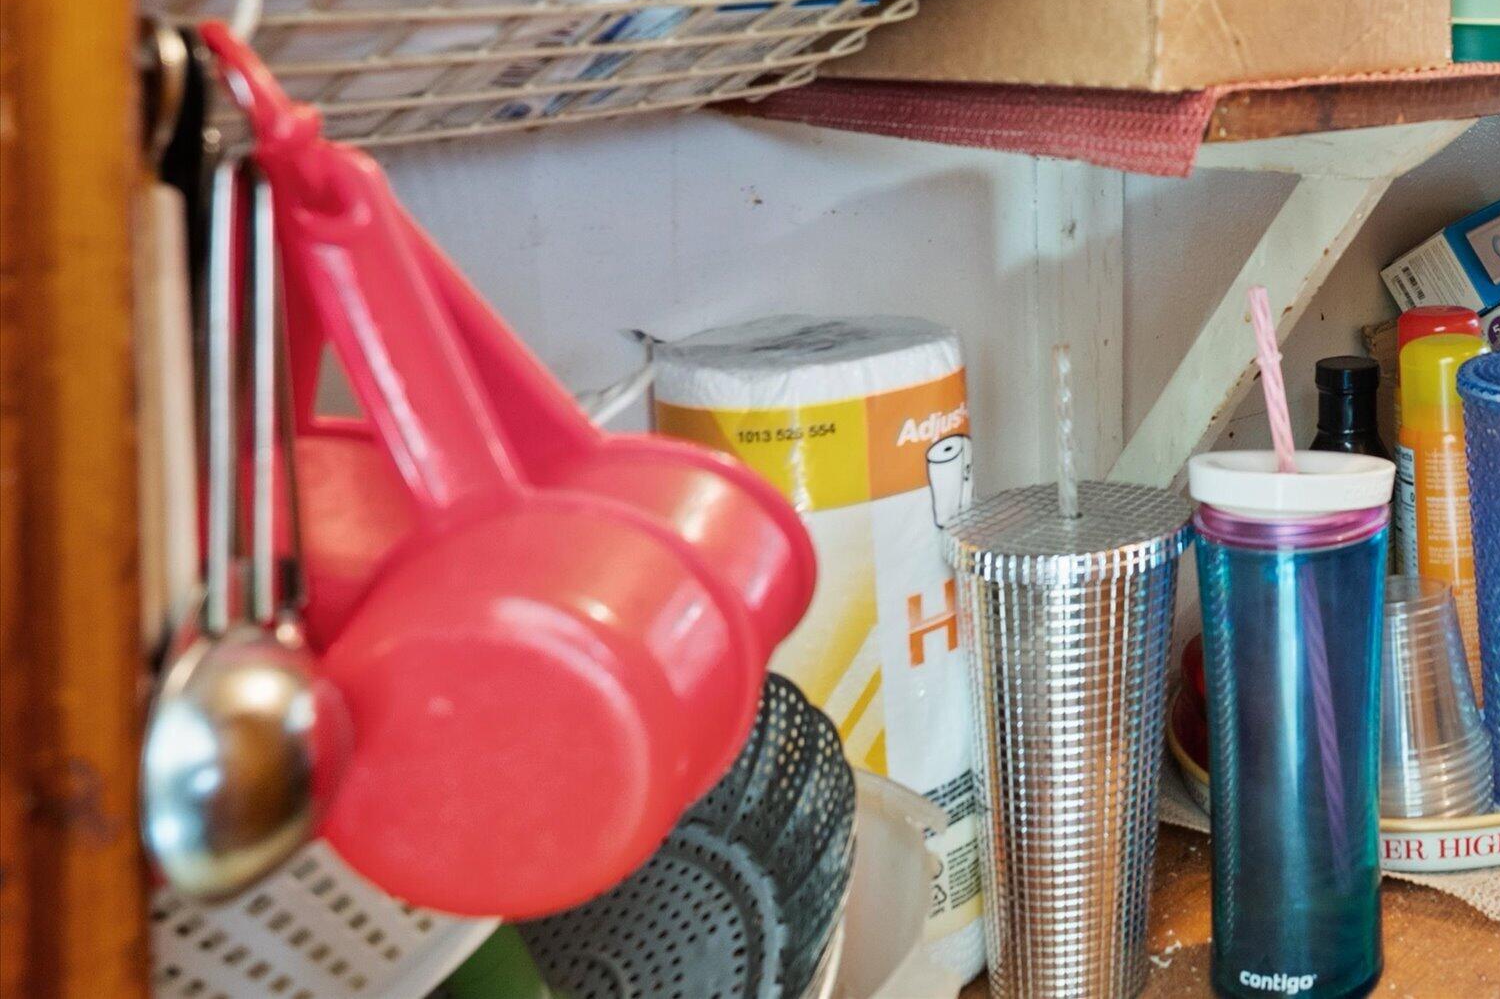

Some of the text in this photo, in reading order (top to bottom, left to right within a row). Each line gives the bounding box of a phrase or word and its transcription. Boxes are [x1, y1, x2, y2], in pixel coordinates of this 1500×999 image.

[736, 428, 773, 444] 1013
[808, 422, 837, 438] 554
[1382, 836, 1430, 863] ER
[1239, 969, 1316, 996] contigo
